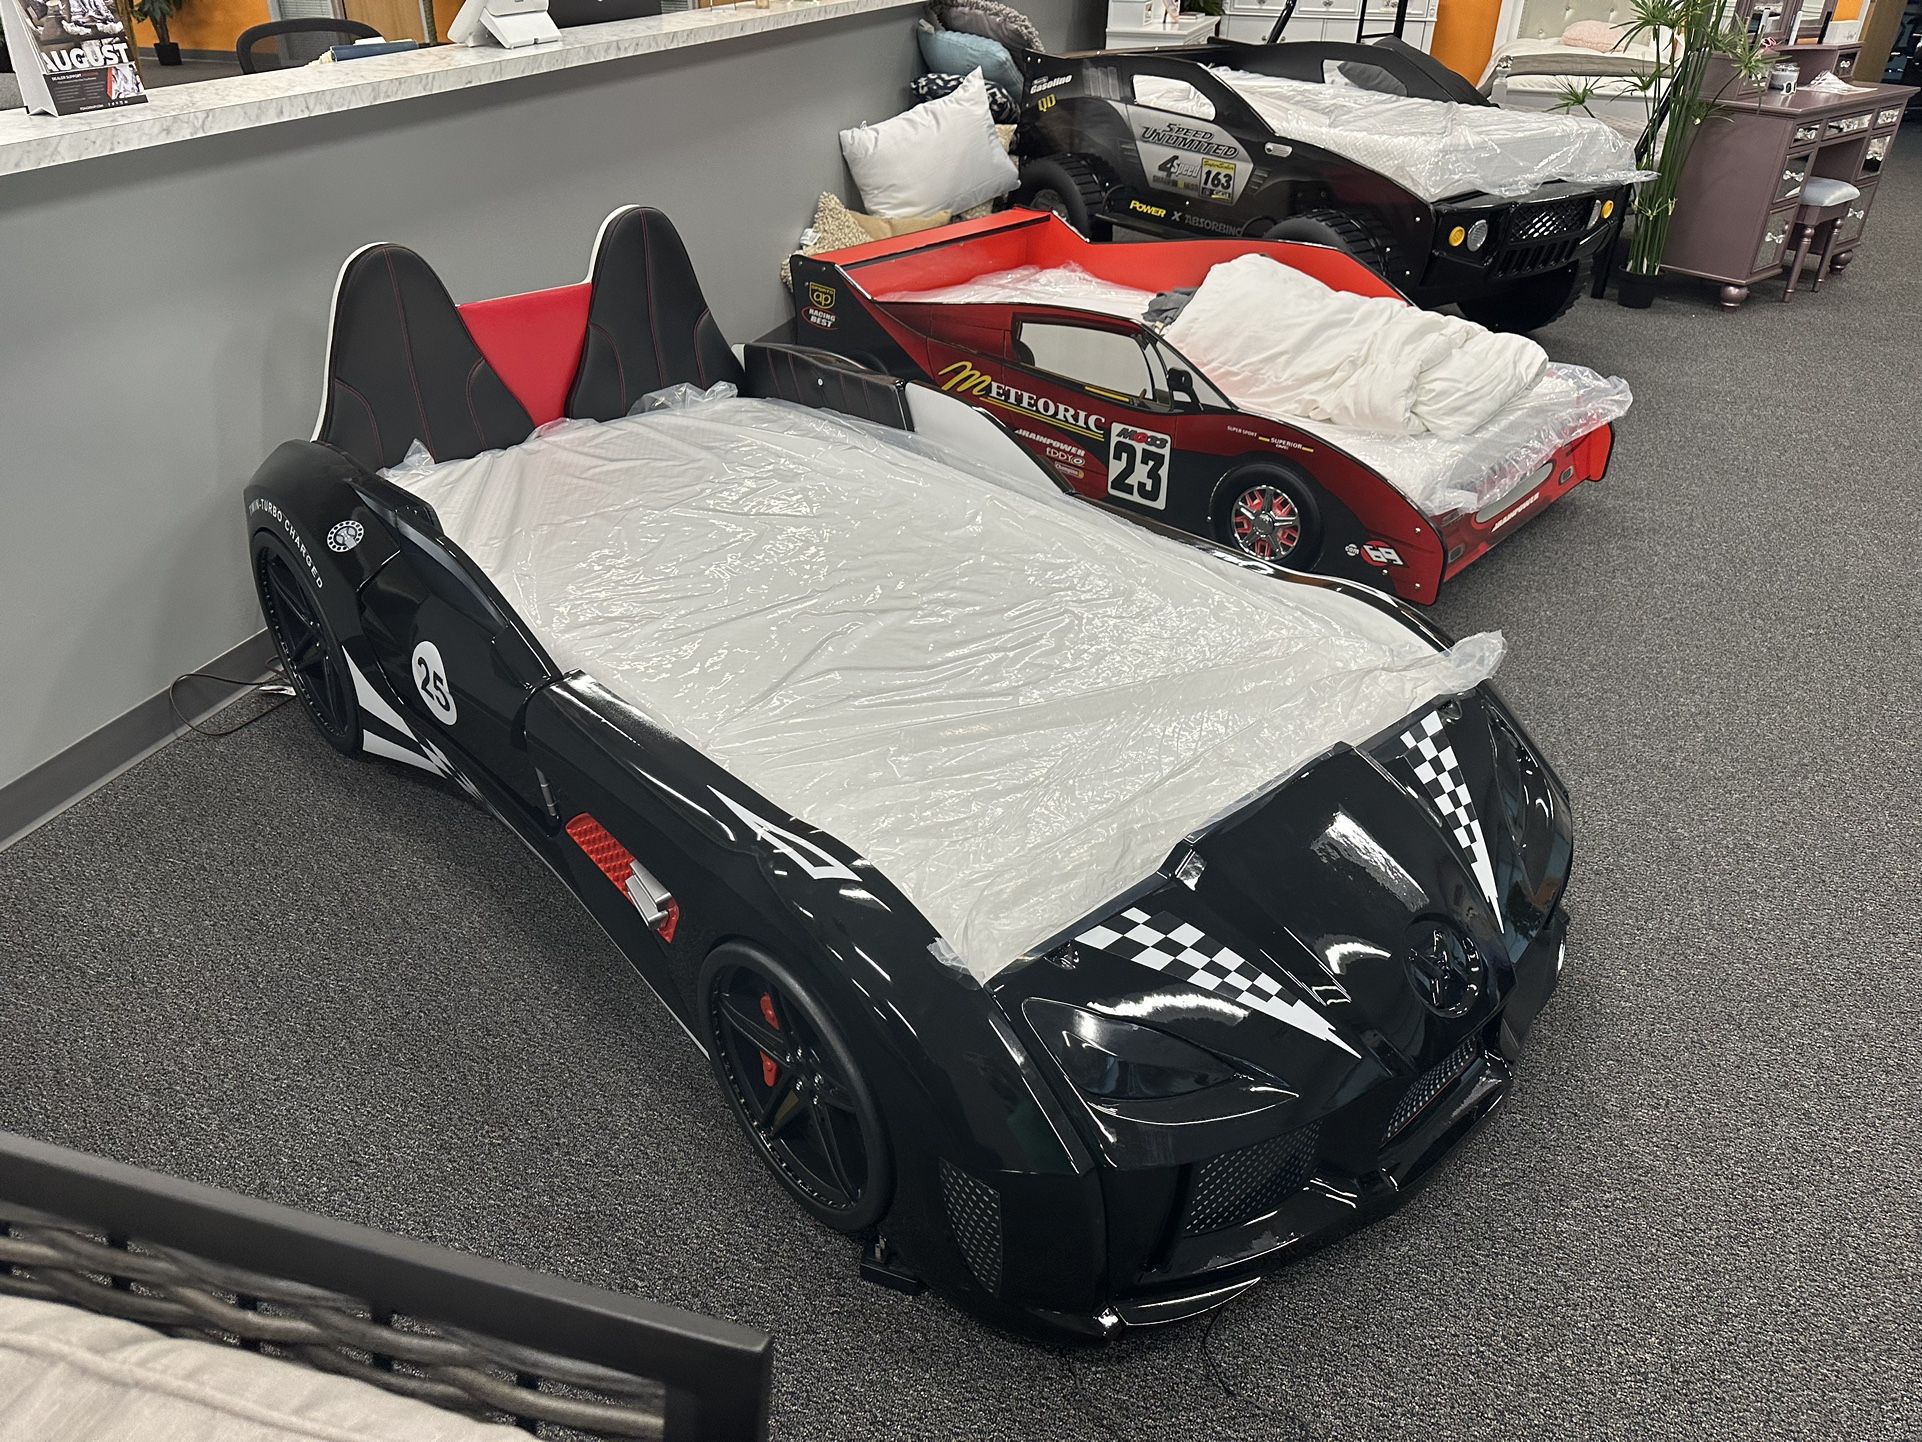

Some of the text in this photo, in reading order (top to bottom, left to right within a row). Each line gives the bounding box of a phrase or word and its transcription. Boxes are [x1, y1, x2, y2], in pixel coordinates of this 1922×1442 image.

[41, 43, 129, 72] AUGUST
[1140, 125, 1239, 160] UNLIMITED
[1162, 122, 1214, 141] SPEED
[1203, 169, 1233, 190] 163
[1129, 200, 1166, 218] POWER
[809, 308, 836, 323] RACING
[810, 315, 833, 328] BEST
[938, 361, 1106, 434] METEORIC
[1110, 440, 1166, 502] 23
[284, 519, 323, 589] CHARGED
[417, 656, 451, 712] 25
